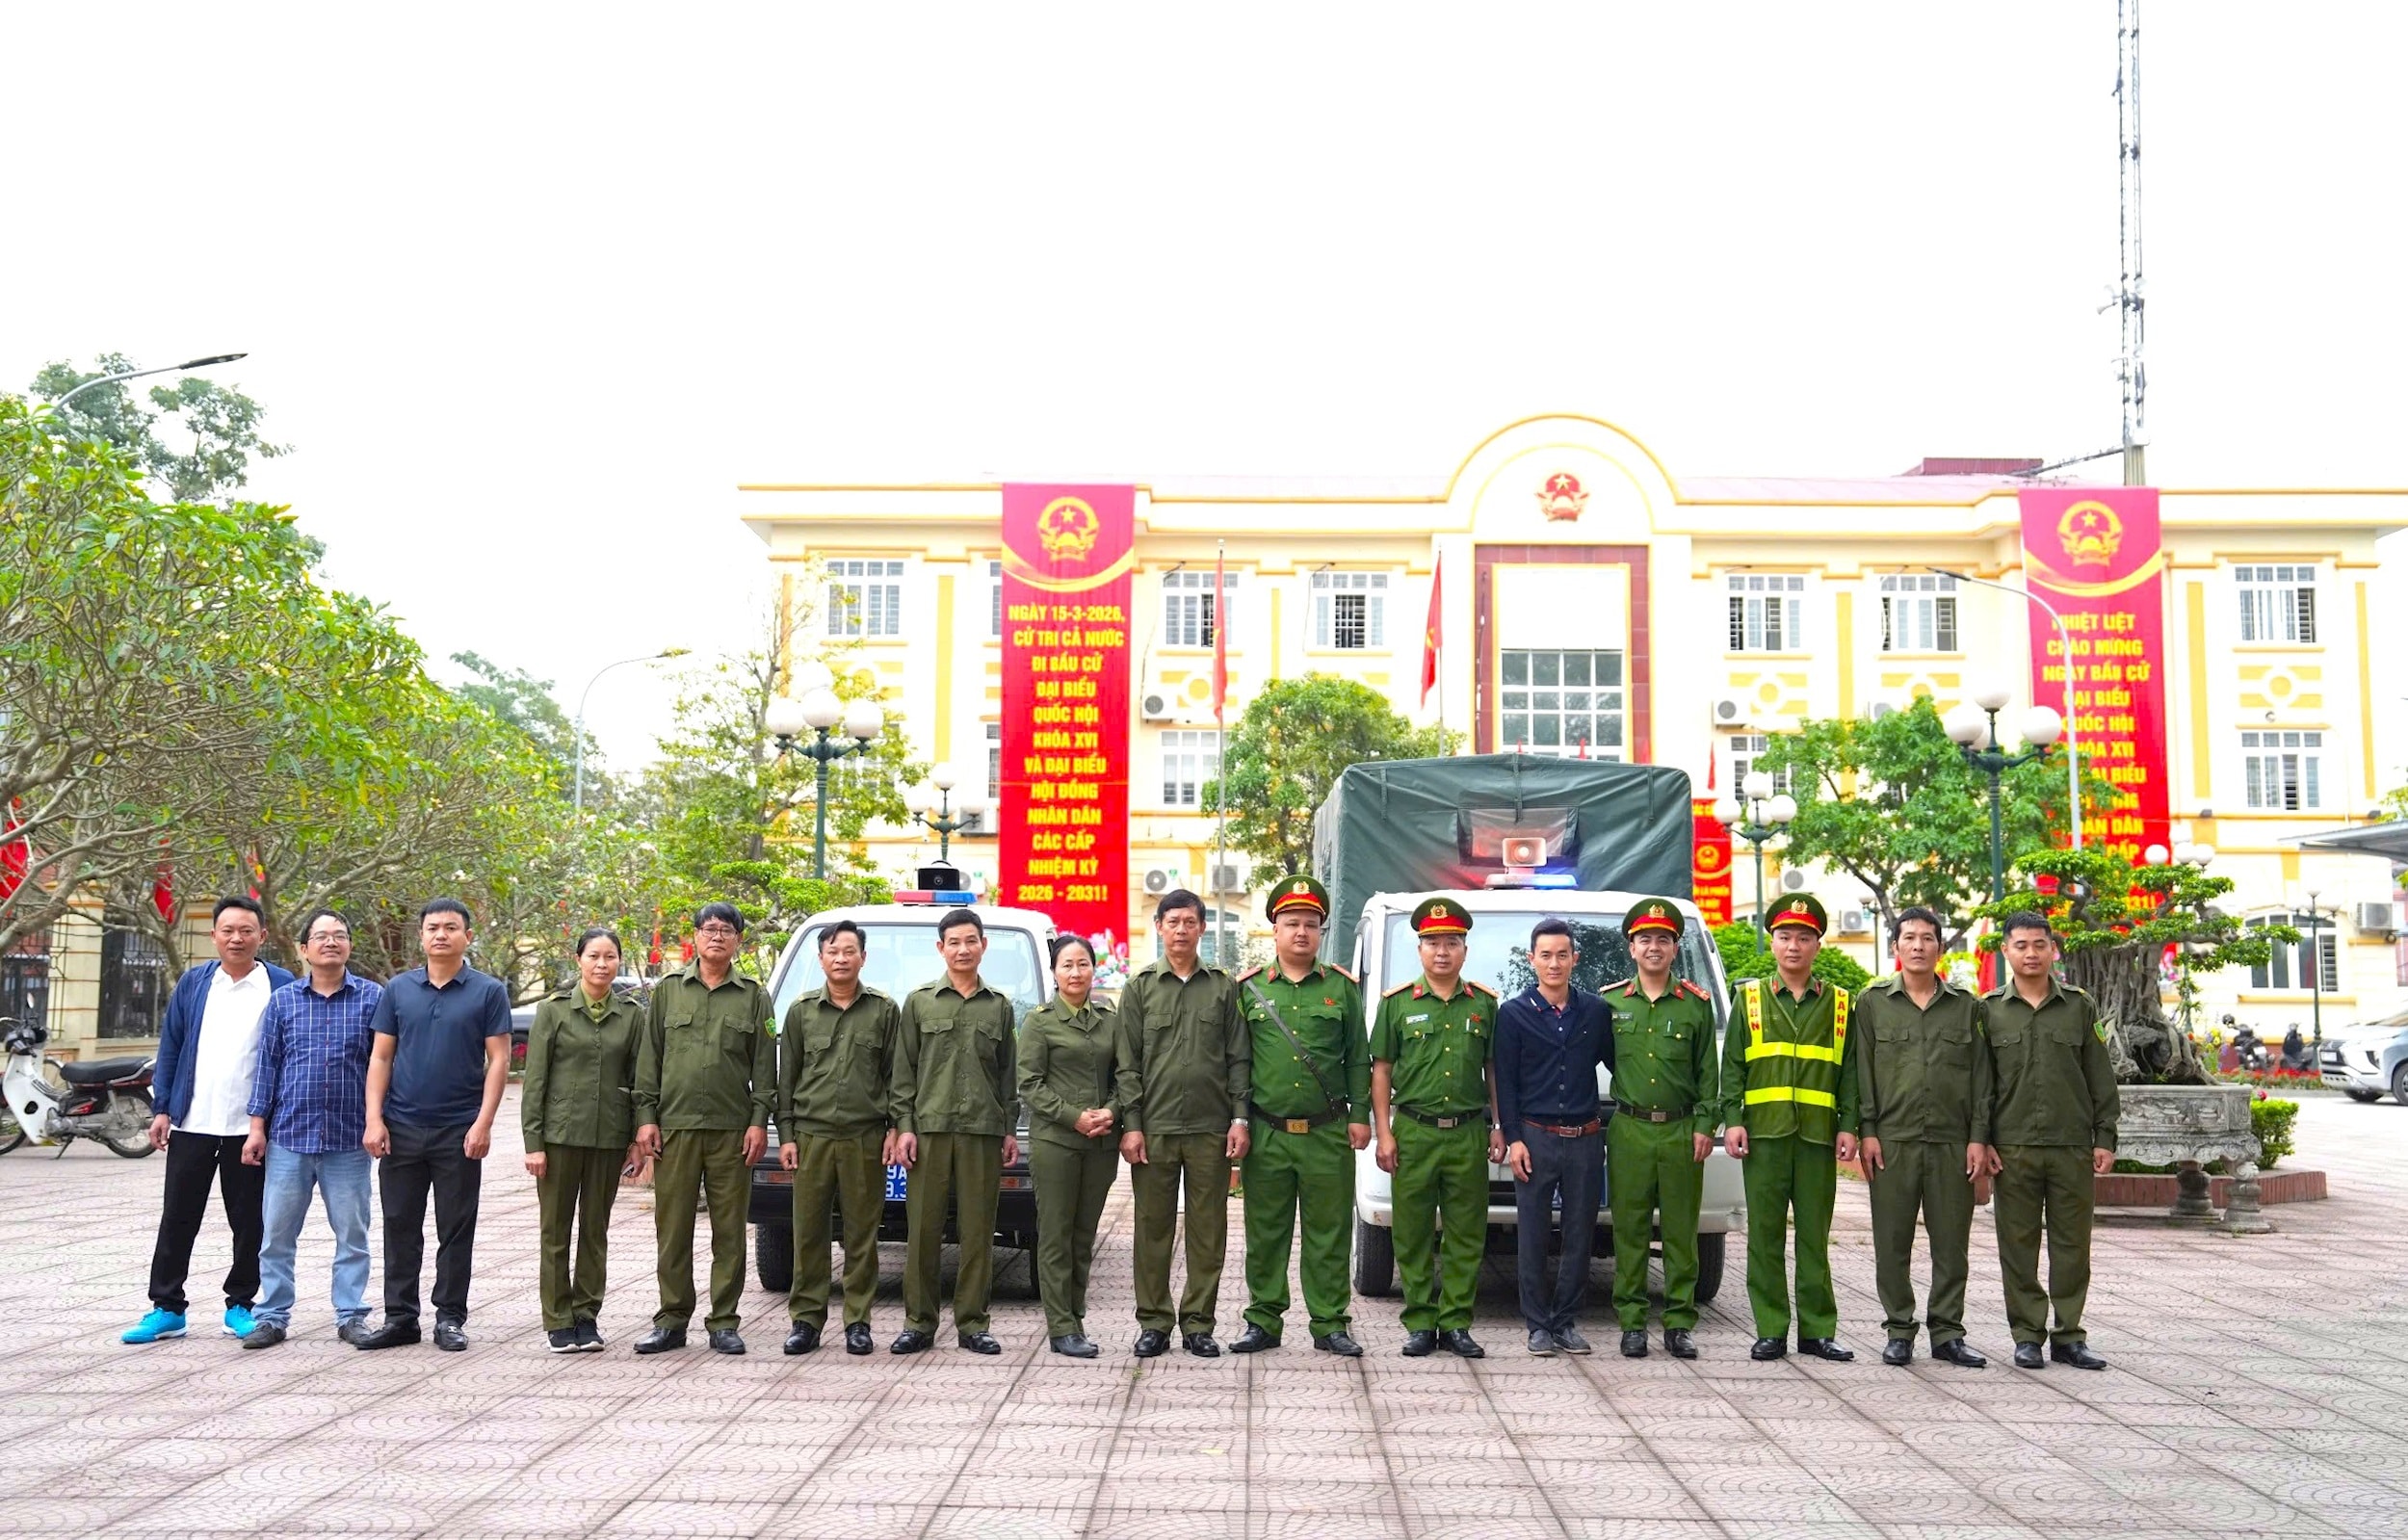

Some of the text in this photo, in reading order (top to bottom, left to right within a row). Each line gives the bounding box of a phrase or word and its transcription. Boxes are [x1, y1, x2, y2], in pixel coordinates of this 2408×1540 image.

[1008, 602, 1125, 623] NGÀY 15-3-2026,
[2103, 611, 2135, 634] LIỆT
[1013, 625, 1124, 646] CỬ TRI CẢ NƯỚC
[2094, 637, 2143, 656] MỪNG
[1032, 656, 1047, 672] ĐI
[1082, 651, 1104, 672] CỬ
[2126, 660, 2151, 682] CỬ
[1036, 675, 1096, 700] ĐẠI BIỂU
[2095, 685, 2131, 707] BIỂU
[1034, 701, 1098, 726] QUỐC HỘI
[2108, 713, 2134, 735] HỘI
[1034, 729, 1098, 748] KHÓA XVI
[2063, 738, 2134, 758] HÓA XVI
[1024, 752, 1107, 776] VÀ ĐẠI BIỂU
[2110, 761, 2146, 783] BIỂU
[1031, 780, 1055, 802] HỘI
[1028, 805, 1102, 824] NHÂN DÂN
[2111, 814, 2144, 835] DÂN
[1033, 828, 1095, 850] CÁC CẤP
[1029, 855, 1099, 879] NHIỆM KỲ
[1018, 884, 1054, 901] 2026
[1066, 884, 1108, 901] 2031!
[886, 1164, 907, 1180] 9A
